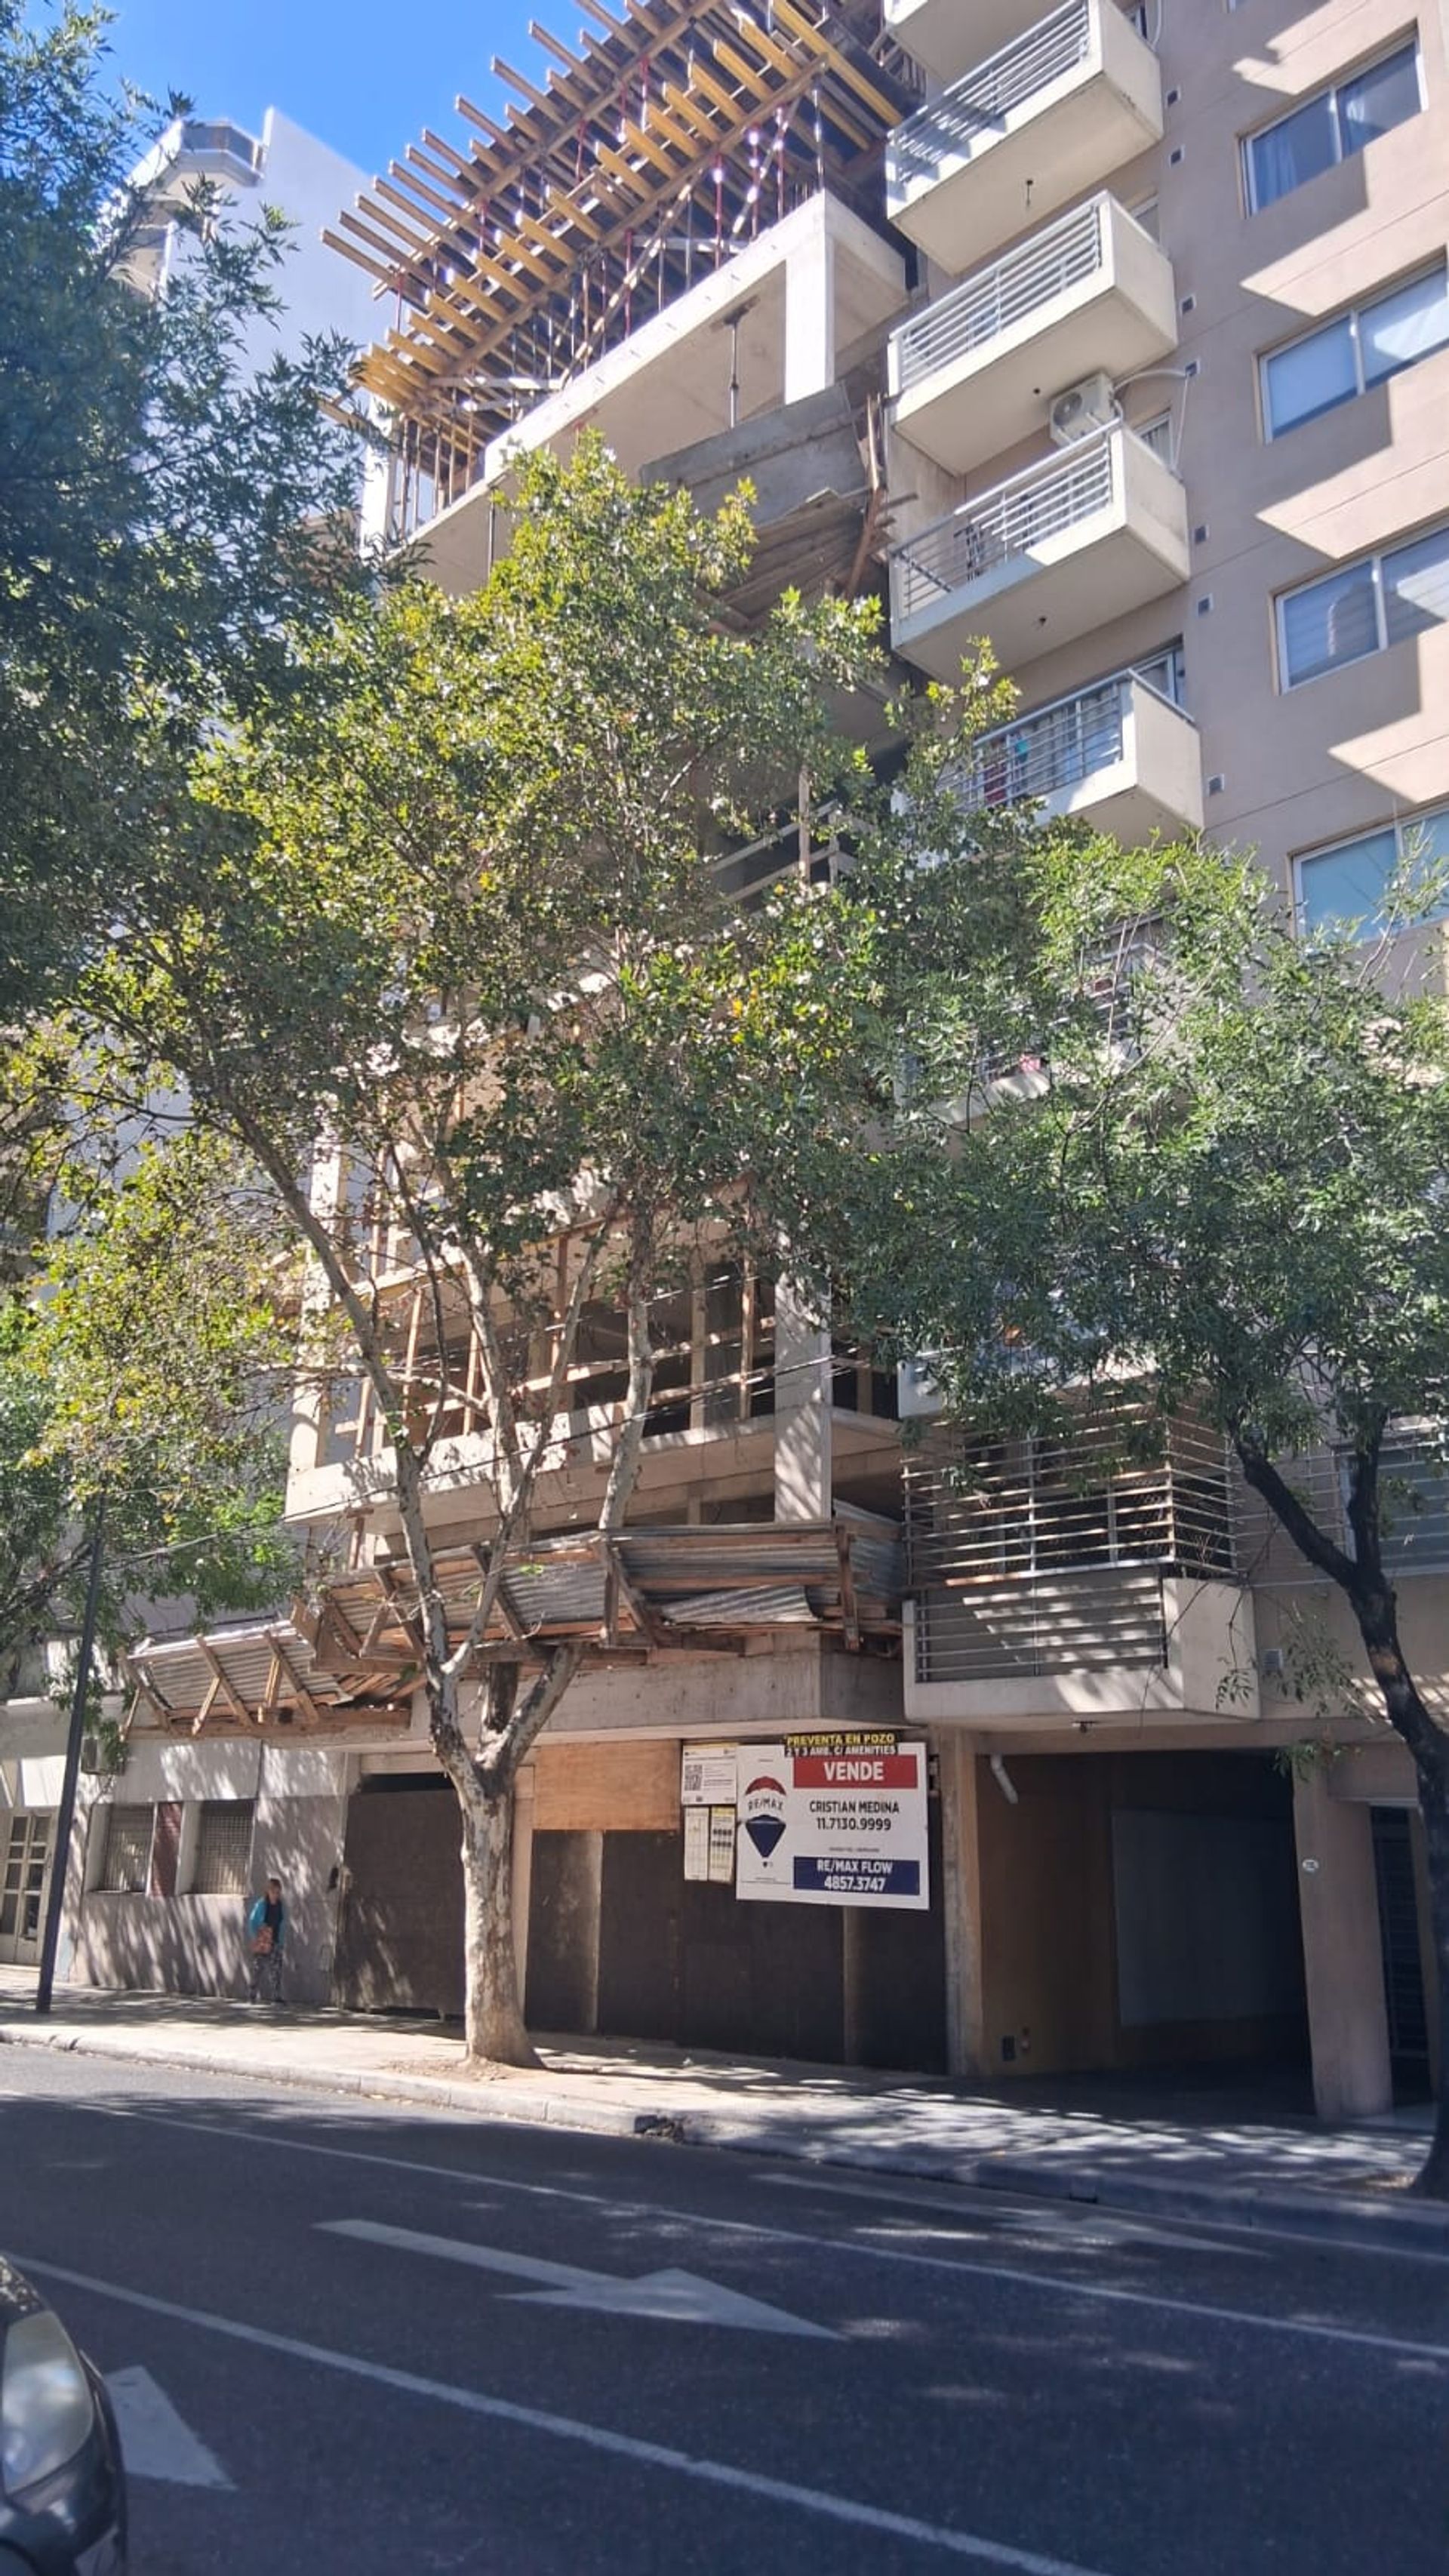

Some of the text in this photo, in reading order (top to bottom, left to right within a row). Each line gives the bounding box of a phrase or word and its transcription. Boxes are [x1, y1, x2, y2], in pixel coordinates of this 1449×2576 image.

[787, 1733, 895, 1747] PREVENTA EN POZO
[824, 1761, 884, 1781] VENDE
[748, 1798, 783, 1811] RE/MAX
[810, 1800, 900, 1814] CRISTIAN MEDINA
[817, 1817, 891, 1831] 11.7130.9999
[817, 1859, 893, 1874] RE/MAX FLOW
[824, 1876, 886, 1891] 4857.3747
